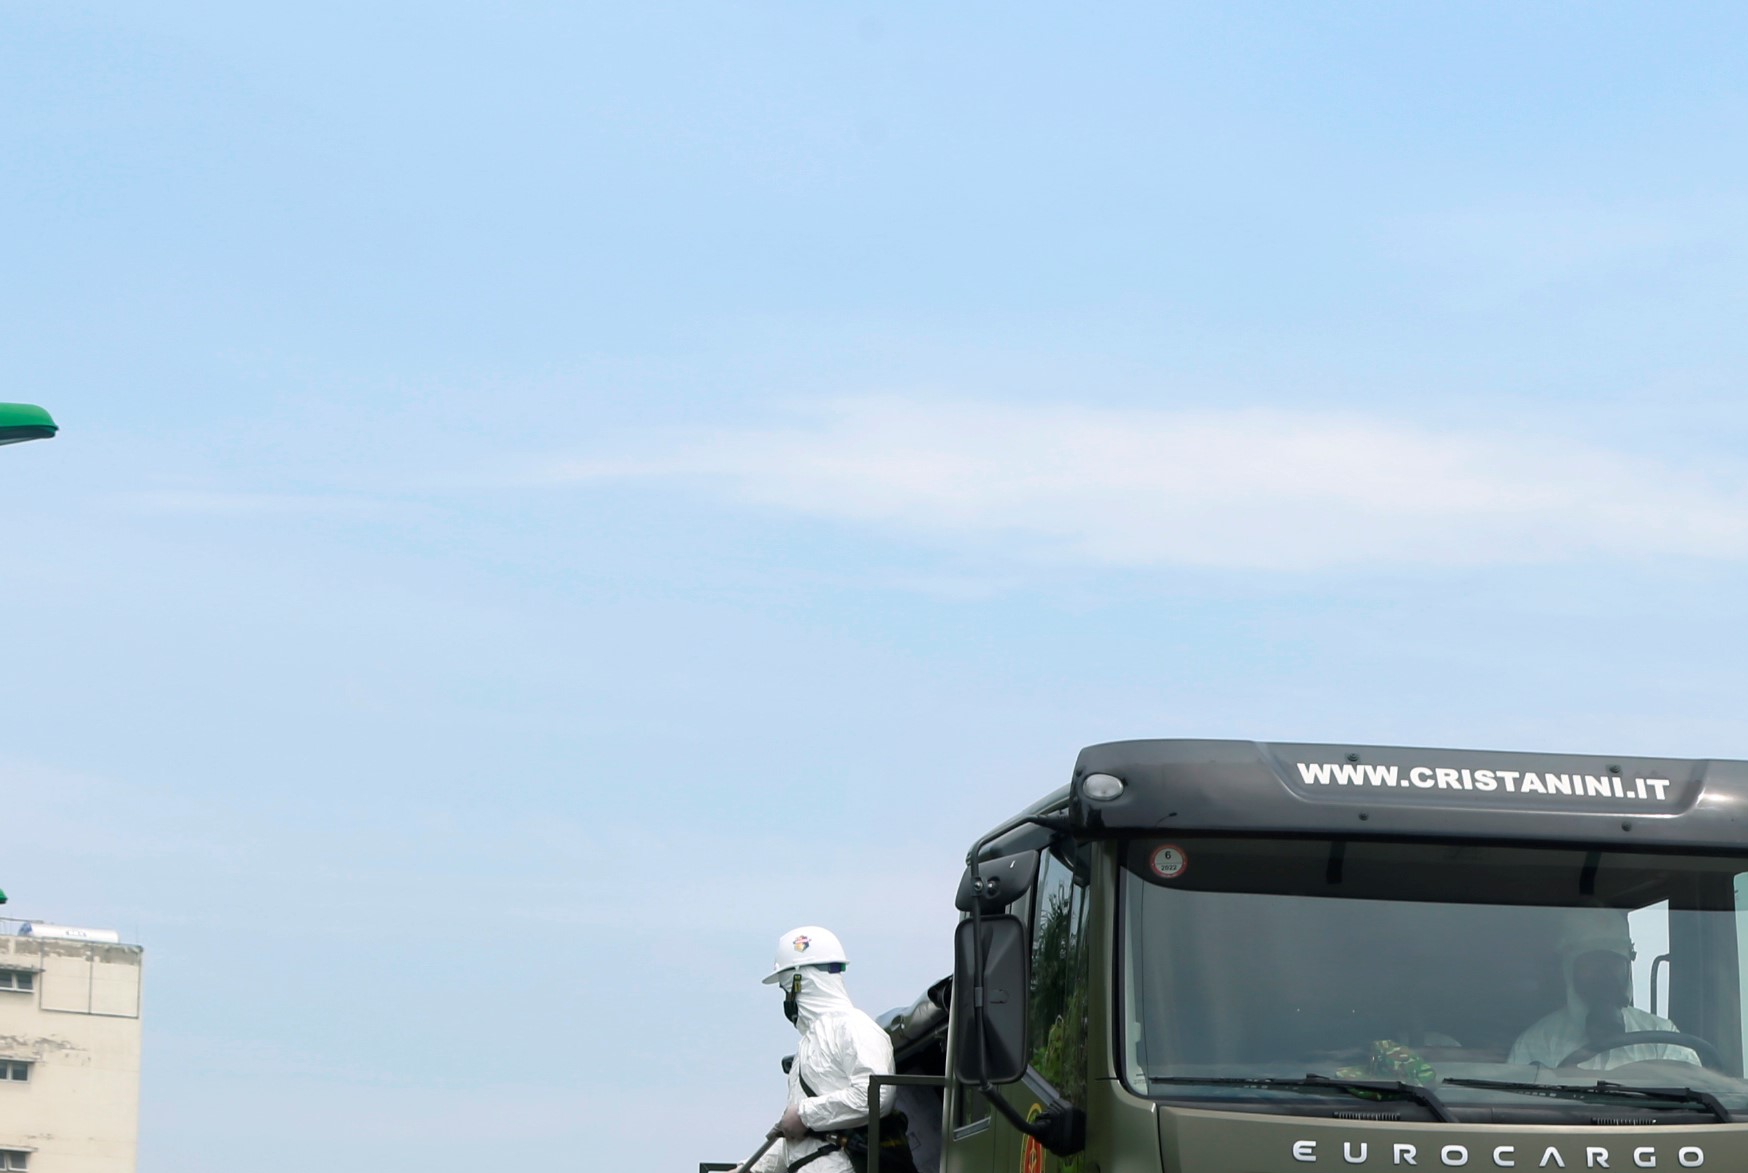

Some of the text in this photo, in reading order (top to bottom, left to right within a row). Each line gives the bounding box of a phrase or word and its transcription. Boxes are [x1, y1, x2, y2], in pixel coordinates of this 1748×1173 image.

[1296, 761, 1670, 801] WWW.CRISTANINI.IT
[1165, 850, 1171, 860] 6
[1292, 1139, 1706, 1169] EUROCARGO
